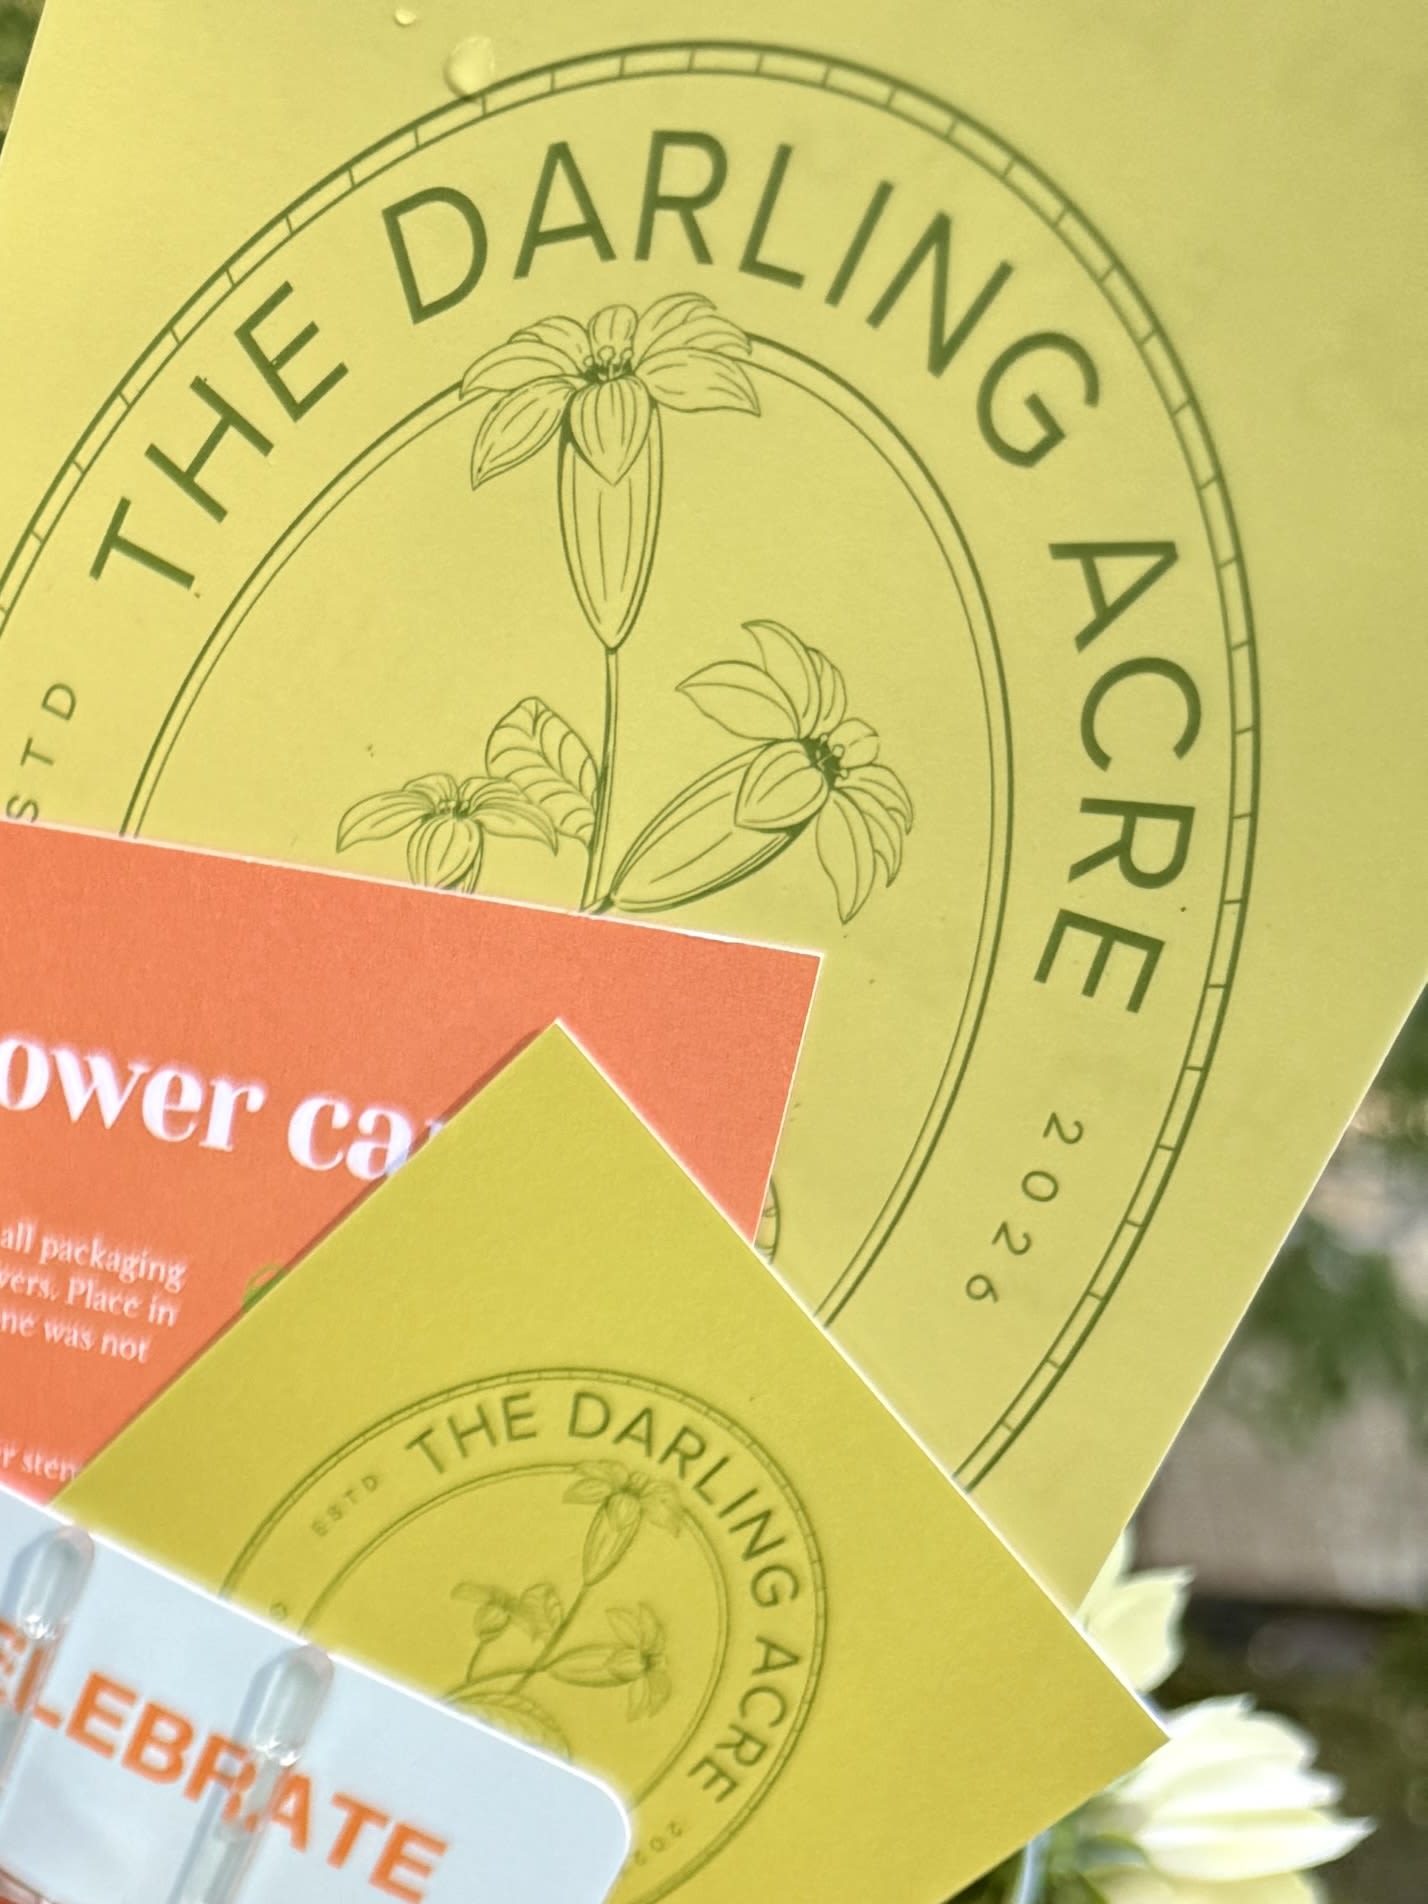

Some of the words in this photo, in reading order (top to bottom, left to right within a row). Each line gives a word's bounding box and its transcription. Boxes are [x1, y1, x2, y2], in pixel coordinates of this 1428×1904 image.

[89, 280, 351, 599] THE
[380, 127, 1103, 471] DARLING
[1032, 536, 1204, 1014] ACRE
[5, 682, 77, 824] STD
[287, 1092, 444, 1181] ca
[0, 1217, 35, 1254] all
[39, 1232, 187, 1294] packaging
[965, 1111, 1084, 1304] 2026
[44, 1318, 93, 1352] was
[100, 1333, 150, 1364] not
[67, 1275, 142, 1318] Place
[148, 1298, 178, 1328] in
[404, 1391, 538, 1475] THE
[567, 1390, 801, 1610] DARLING
[686, 1634, 801, 1804] ACRE
